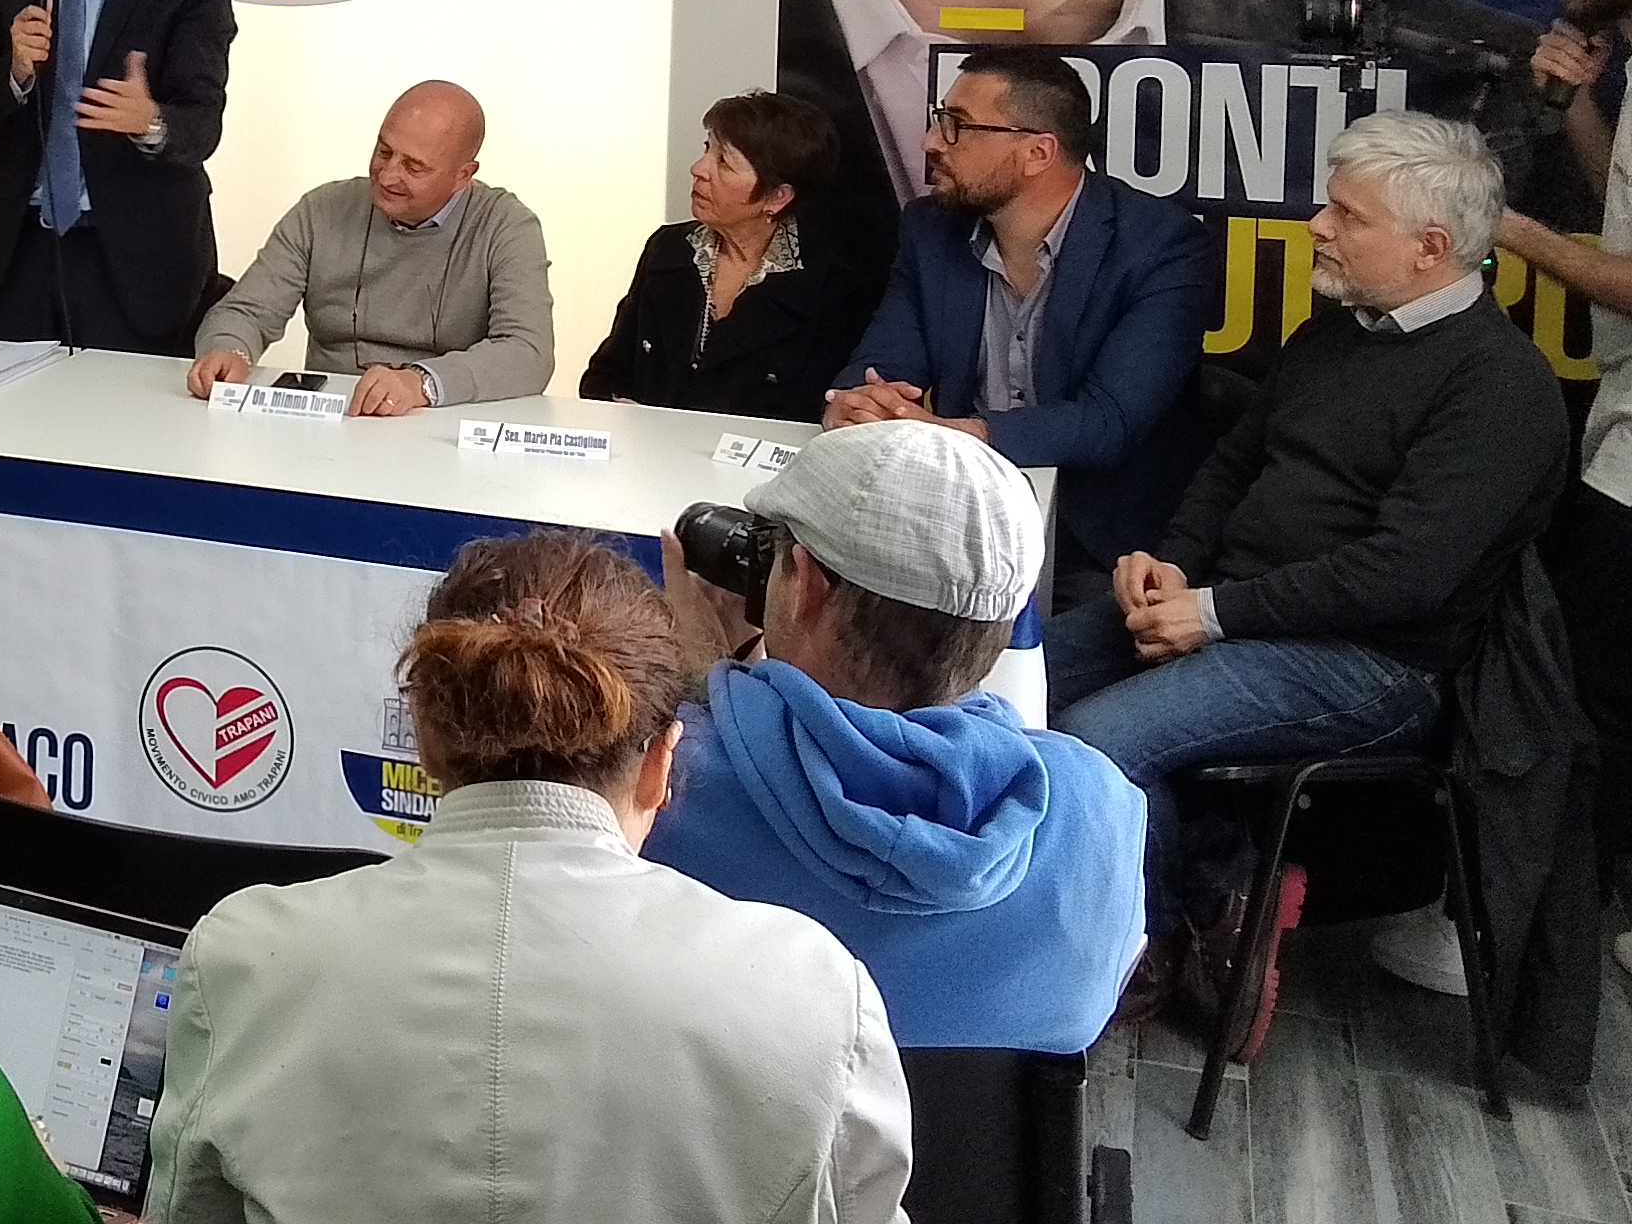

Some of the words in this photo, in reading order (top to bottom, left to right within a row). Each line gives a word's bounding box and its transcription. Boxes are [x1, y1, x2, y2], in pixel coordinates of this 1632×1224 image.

[252, 389, 268, 407] On.
[271, 391, 309, 410] Mimmo
[310, 394, 344, 414] Turano
[504, 429, 521, 443] Sen.
[523, 431, 548, 445] Maria
[550, 433, 561, 446] Pia
[564, 434, 607, 449] Castiglione
[218, 705, 276, 743] TRAPANI
[146, 728, 187, 791] MOVIMENTO
[190, 788, 229, 805] CIVICO
[233, 788, 257, 805] AMO
[257, 749, 286, 792] TRAPANI
[382, 761, 443, 797] MICE
[381, 788, 443, 817] SINDA
